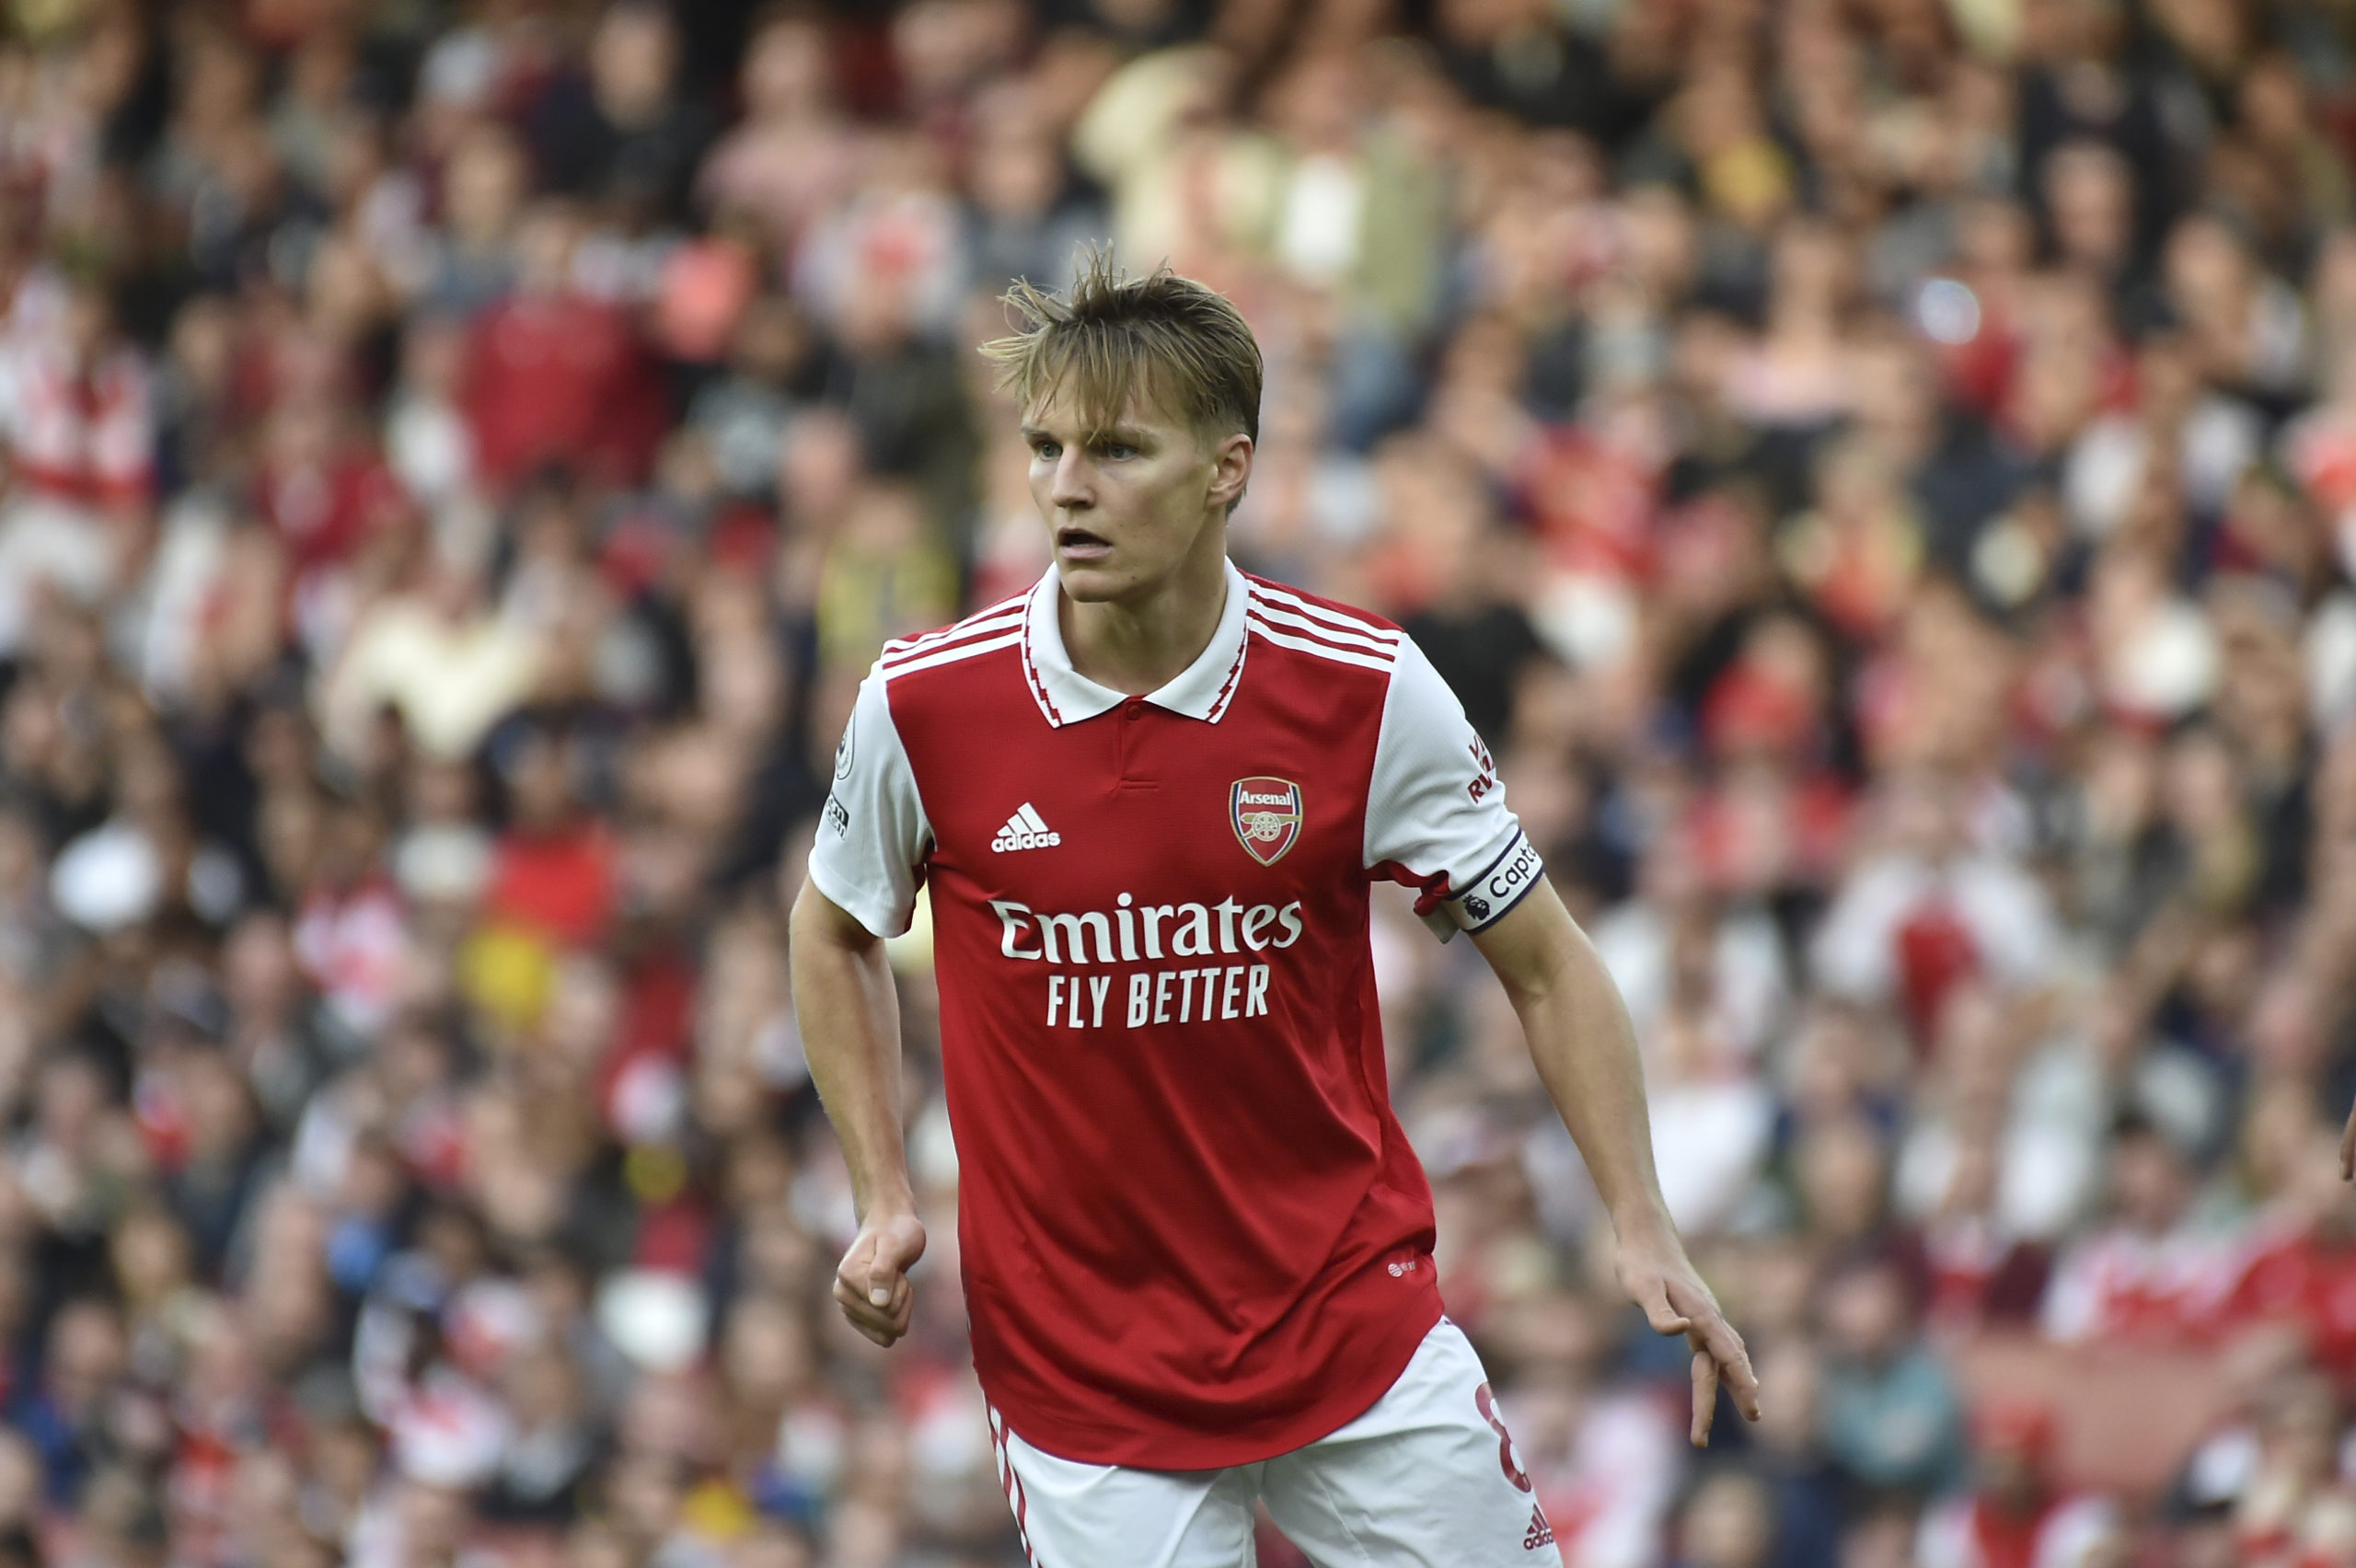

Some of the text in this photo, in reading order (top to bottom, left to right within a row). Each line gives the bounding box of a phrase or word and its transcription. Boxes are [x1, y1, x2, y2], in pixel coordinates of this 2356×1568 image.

[1240, 790, 1292, 805] Arsenal
[990, 831, 1061, 853] adidas
[987, 892, 1302, 964] Emirates
[1046, 963, 1270, 1029] FLY BETTER
